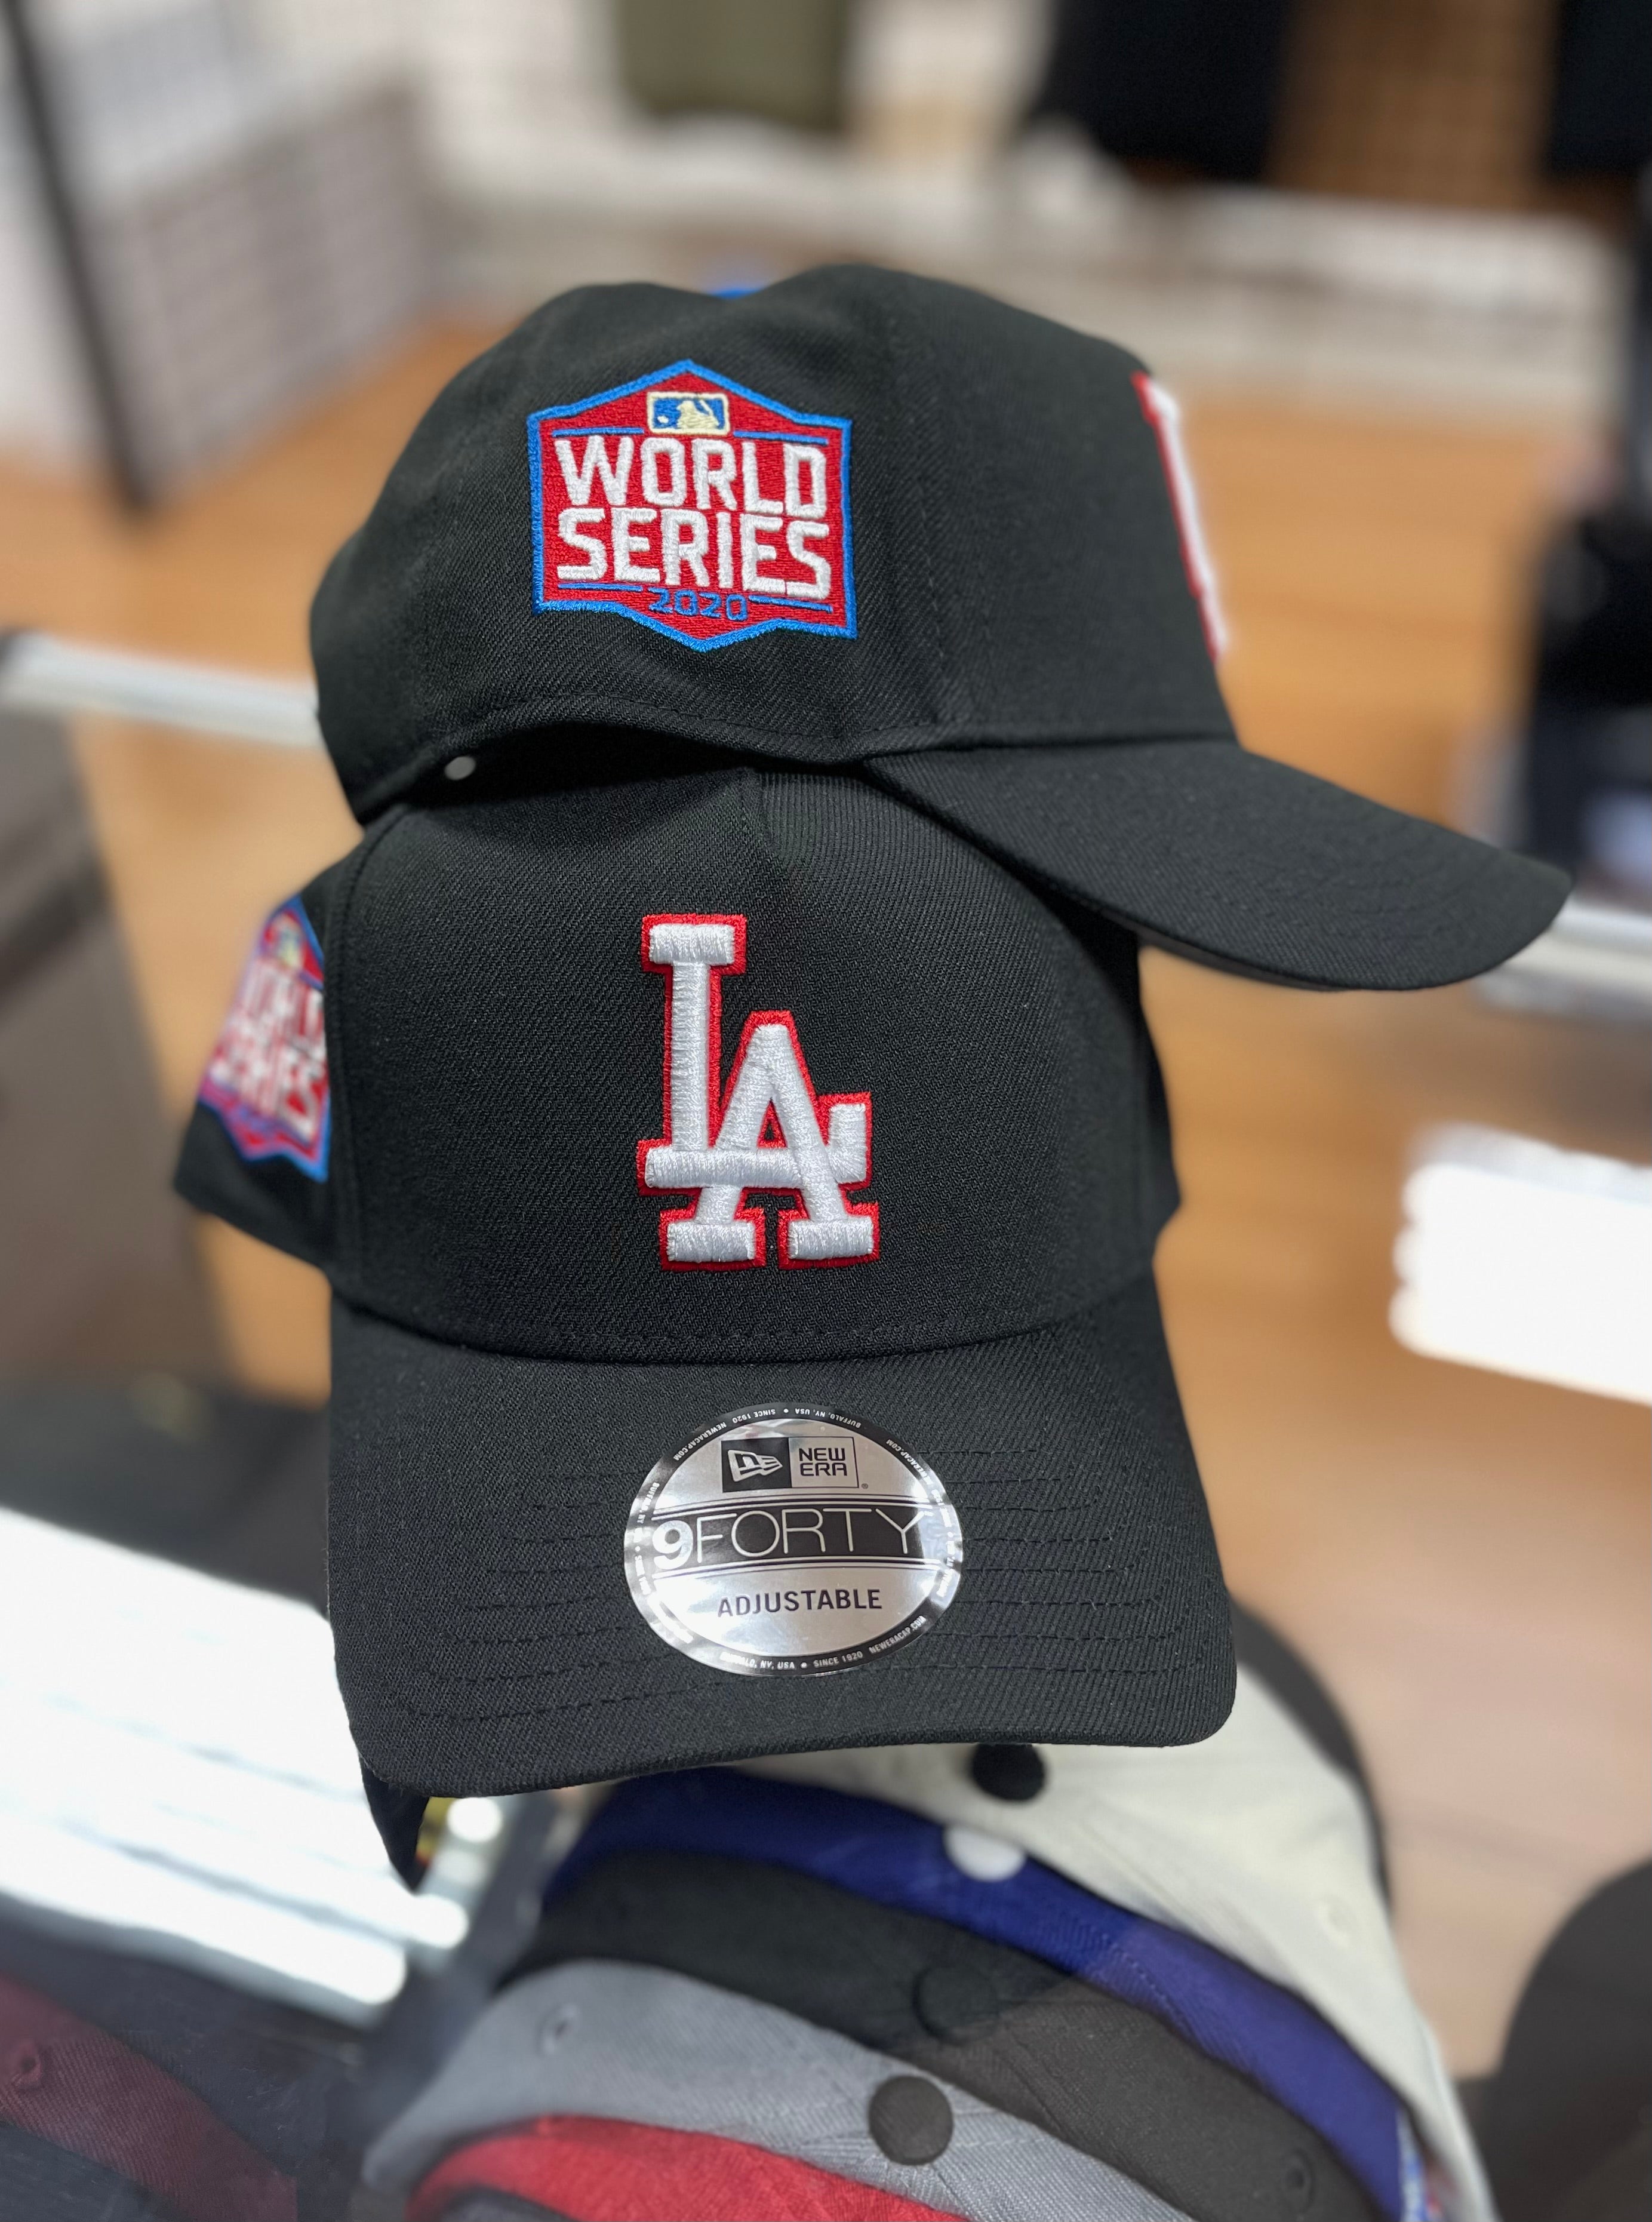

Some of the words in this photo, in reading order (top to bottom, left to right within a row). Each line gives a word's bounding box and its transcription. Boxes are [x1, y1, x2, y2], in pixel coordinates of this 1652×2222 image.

[554, 435, 827, 519] WORLD
[556, 507, 831, 601] SERIES
[648, 586, 749, 621] 2020
[636, 914, 880, 1270] LA
[732, 1413, 751, 1424] 1920
[753, 1409, 776, 1418] SINCE
[673, 1422, 727, 1461] NEWERACAP.COM
[799, 1447, 846, 1462] NEW
[800, 1462, 847, 1476] ERA
[652, 1508, 925, 1570] 9FORTY
[718, 1588, 882, 1618] ADJUSTABLE
[813, 1656, 839, 1668] SINCE
[842, 1651, 863, 1663] 1920
[869, 1615, 926, 1654] NEWERACAP.COM
[777, 1661, 795, 1670] USA
